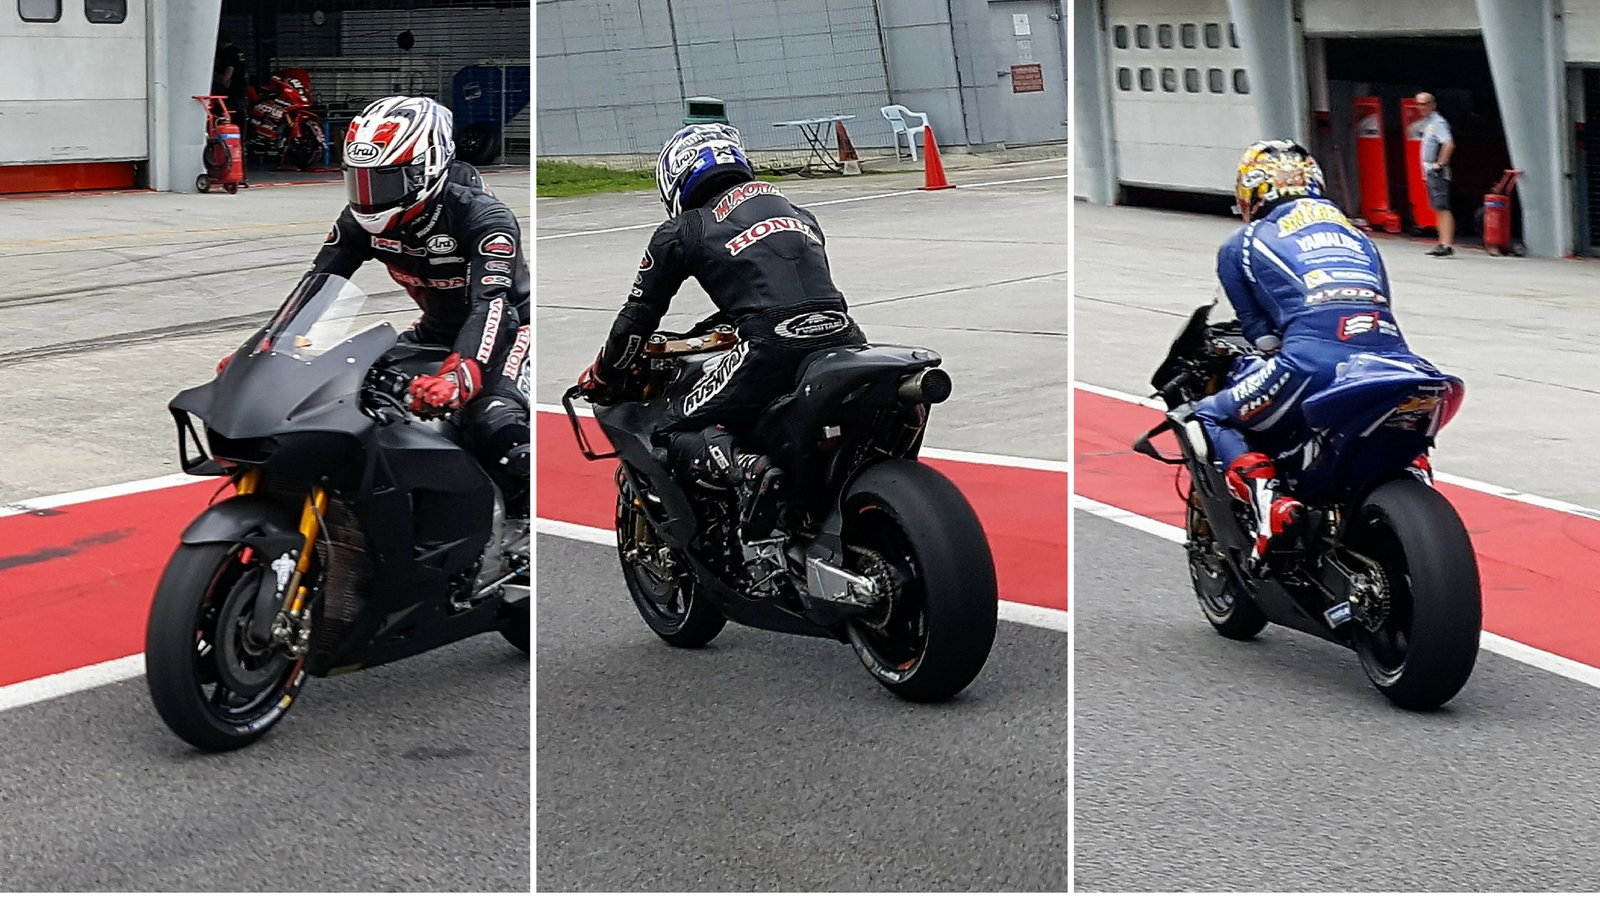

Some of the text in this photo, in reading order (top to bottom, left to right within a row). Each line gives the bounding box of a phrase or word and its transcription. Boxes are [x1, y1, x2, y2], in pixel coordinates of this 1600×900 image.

[347, 144, 374, 156] Arai
[675, 149, 693, 169] Arai
[479, 299, 502, 363] HONDA
